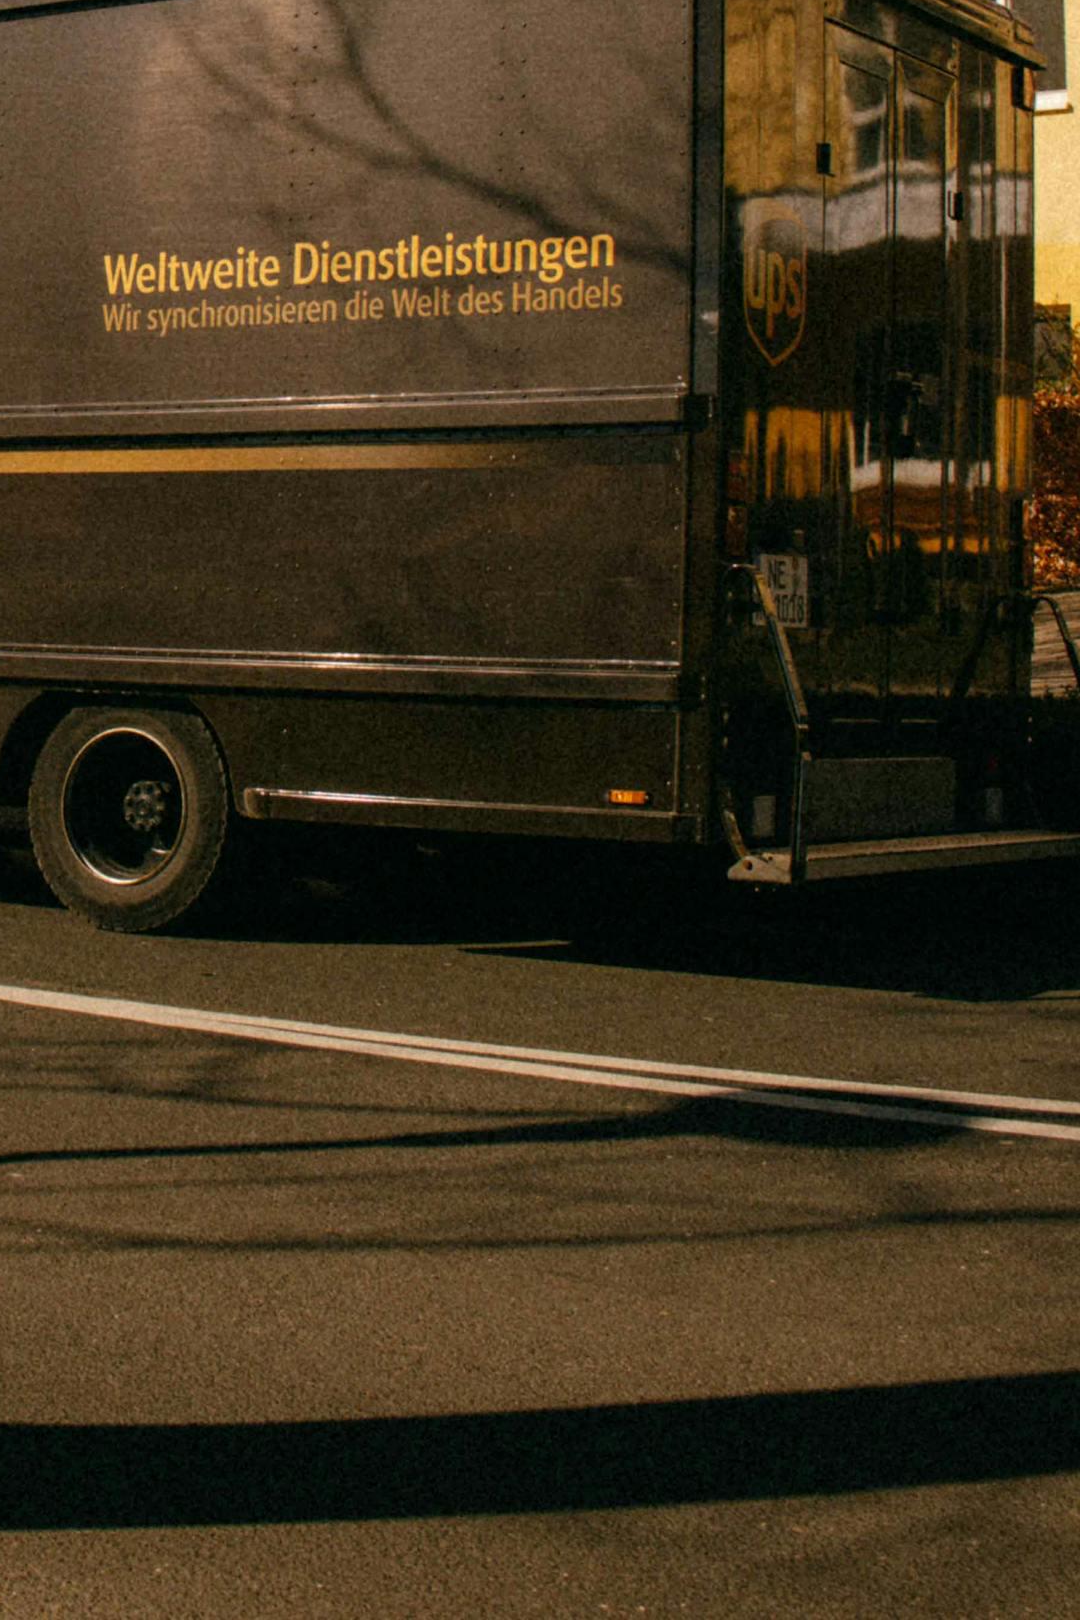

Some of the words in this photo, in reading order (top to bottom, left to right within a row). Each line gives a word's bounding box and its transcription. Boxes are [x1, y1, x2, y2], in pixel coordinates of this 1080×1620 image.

[103, 246, 280, 295] Weltweite
[293, 233, 614, 284] Dienstleistungen
[748, 248, 801, 339] ups
[102, 302, 142, 333] Wir
[146, 295, 337, 337] synchronisieren
[344, 290, 385, 322] die
[391, 287, 451, 318] Welt
[457, 284, 504, 314] des
[512, 277, 623, 312] Handels
